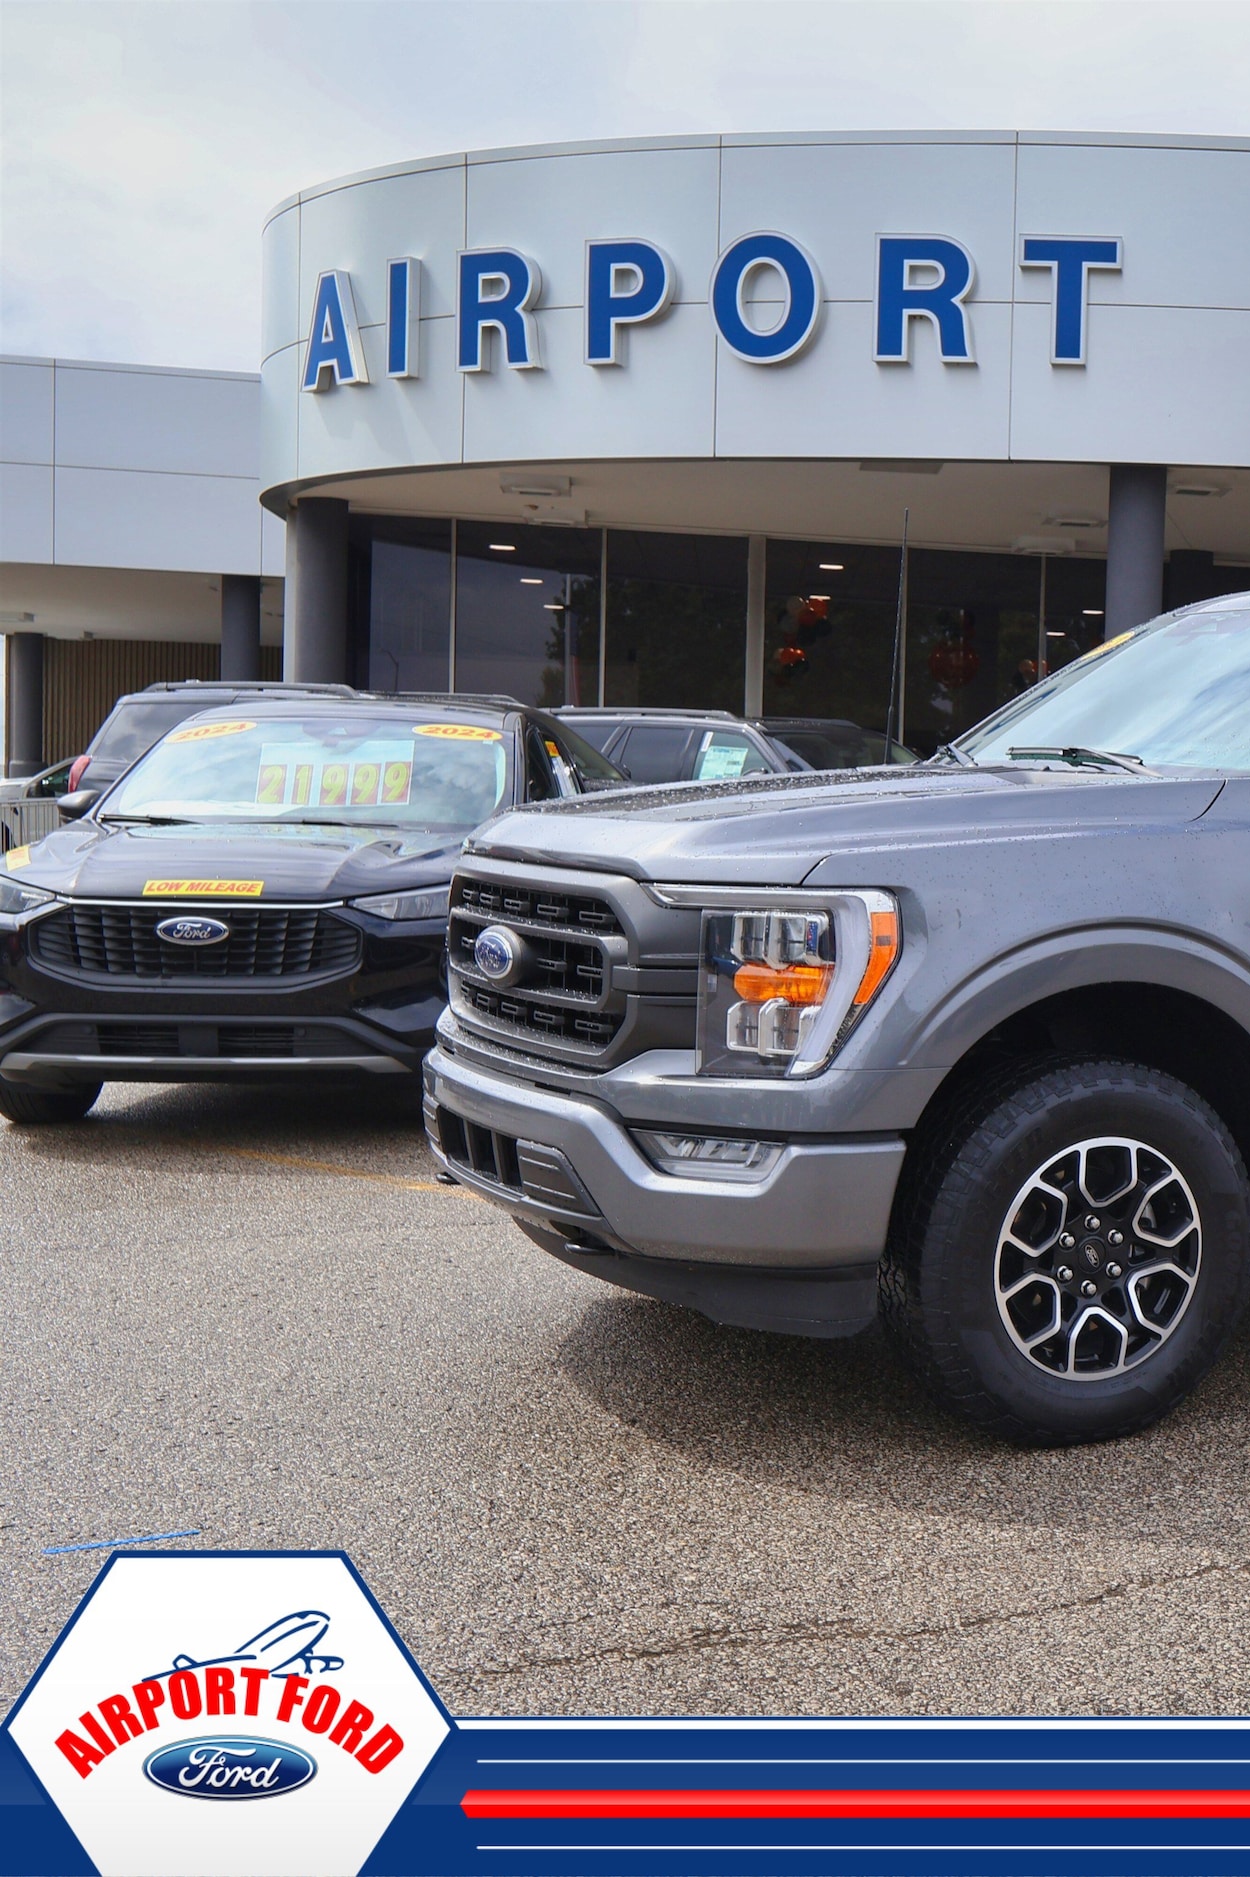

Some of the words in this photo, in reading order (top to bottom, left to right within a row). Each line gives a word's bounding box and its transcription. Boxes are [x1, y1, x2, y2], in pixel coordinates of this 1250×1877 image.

[302, 232, 1122, 391] AIRPORT
[175, 722, 248, 741] 2024
[422, 725, 496, 740] 2024
[256, 762, 411, 804] 21999
[146, 881, 184, 892] LOW
[185, 881, 261, 893] MILEAGE
[172, 922, 212, 939] Ford
